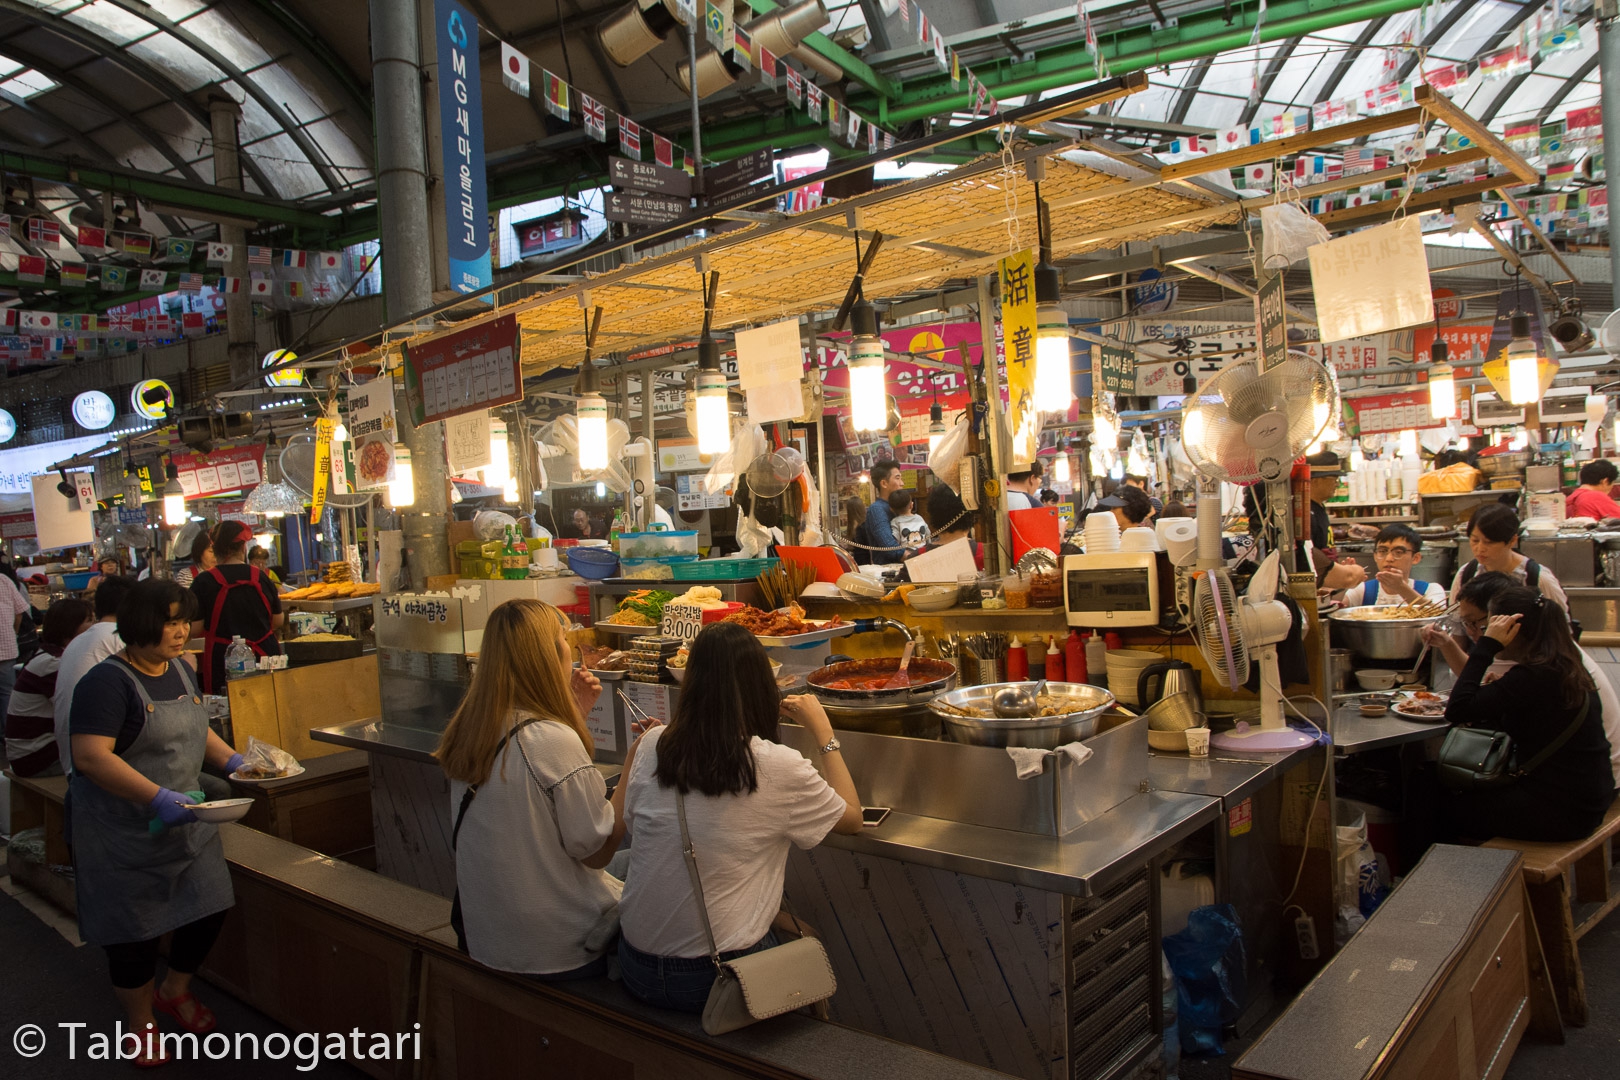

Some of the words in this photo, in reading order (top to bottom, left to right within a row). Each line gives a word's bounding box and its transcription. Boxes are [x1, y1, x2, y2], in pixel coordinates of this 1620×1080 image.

[452, 48, 477, 247] MG새마을금고
[633, 164, 656, 176] 종로4가
[630, 198, 643, 208] 서문
[1142, 325, 1163, 337] KBS
[334, 459, 344, 473] 63
[81, 486, 93, 496] 61
[381, 598, 401, 618] 즉석
[404, 601, 448, 622] 야채곱창
[665, 604, 702, 620] 마약김밥
[664, 618, 700, 639] 3,000
